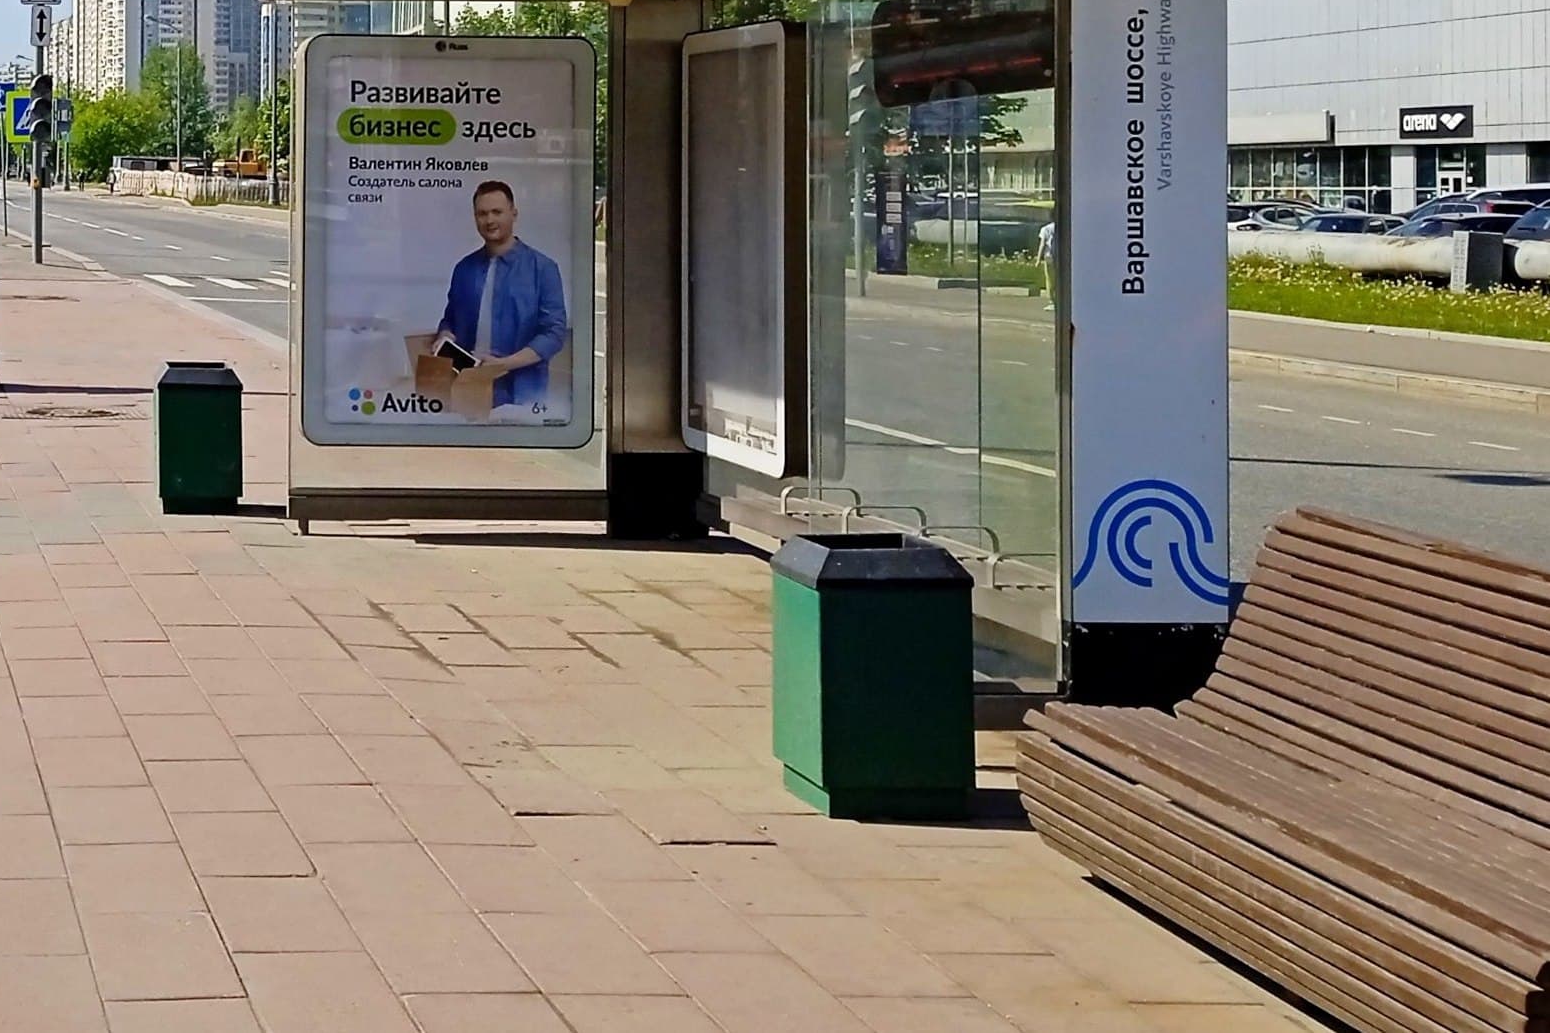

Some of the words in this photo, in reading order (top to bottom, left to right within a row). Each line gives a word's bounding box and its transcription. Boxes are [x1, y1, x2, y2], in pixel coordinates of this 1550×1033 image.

[1126, 8, 1149, 104] шоссе,
[350, 80, 501, 105] Развивайте
[349, 114, 442, 138] бизнес
[462, 120, 536, 143] здесь
[1156, 70, 1175, 191] Varshavskoye
[1403, 114, 1438, 132] arena
[349, 156, 422, 171] Валентин
[425, 157, 489, 172] Яковлев
[348, 175, 416, 189] Создатель
[418, 178, 463, 188] салона
[347, 192, 383, 203] связи
[1121, 119, 1150, 295] Варшавское
[381, 392, 443, 413] Avito
[531, 401, 549, 415] 6+
